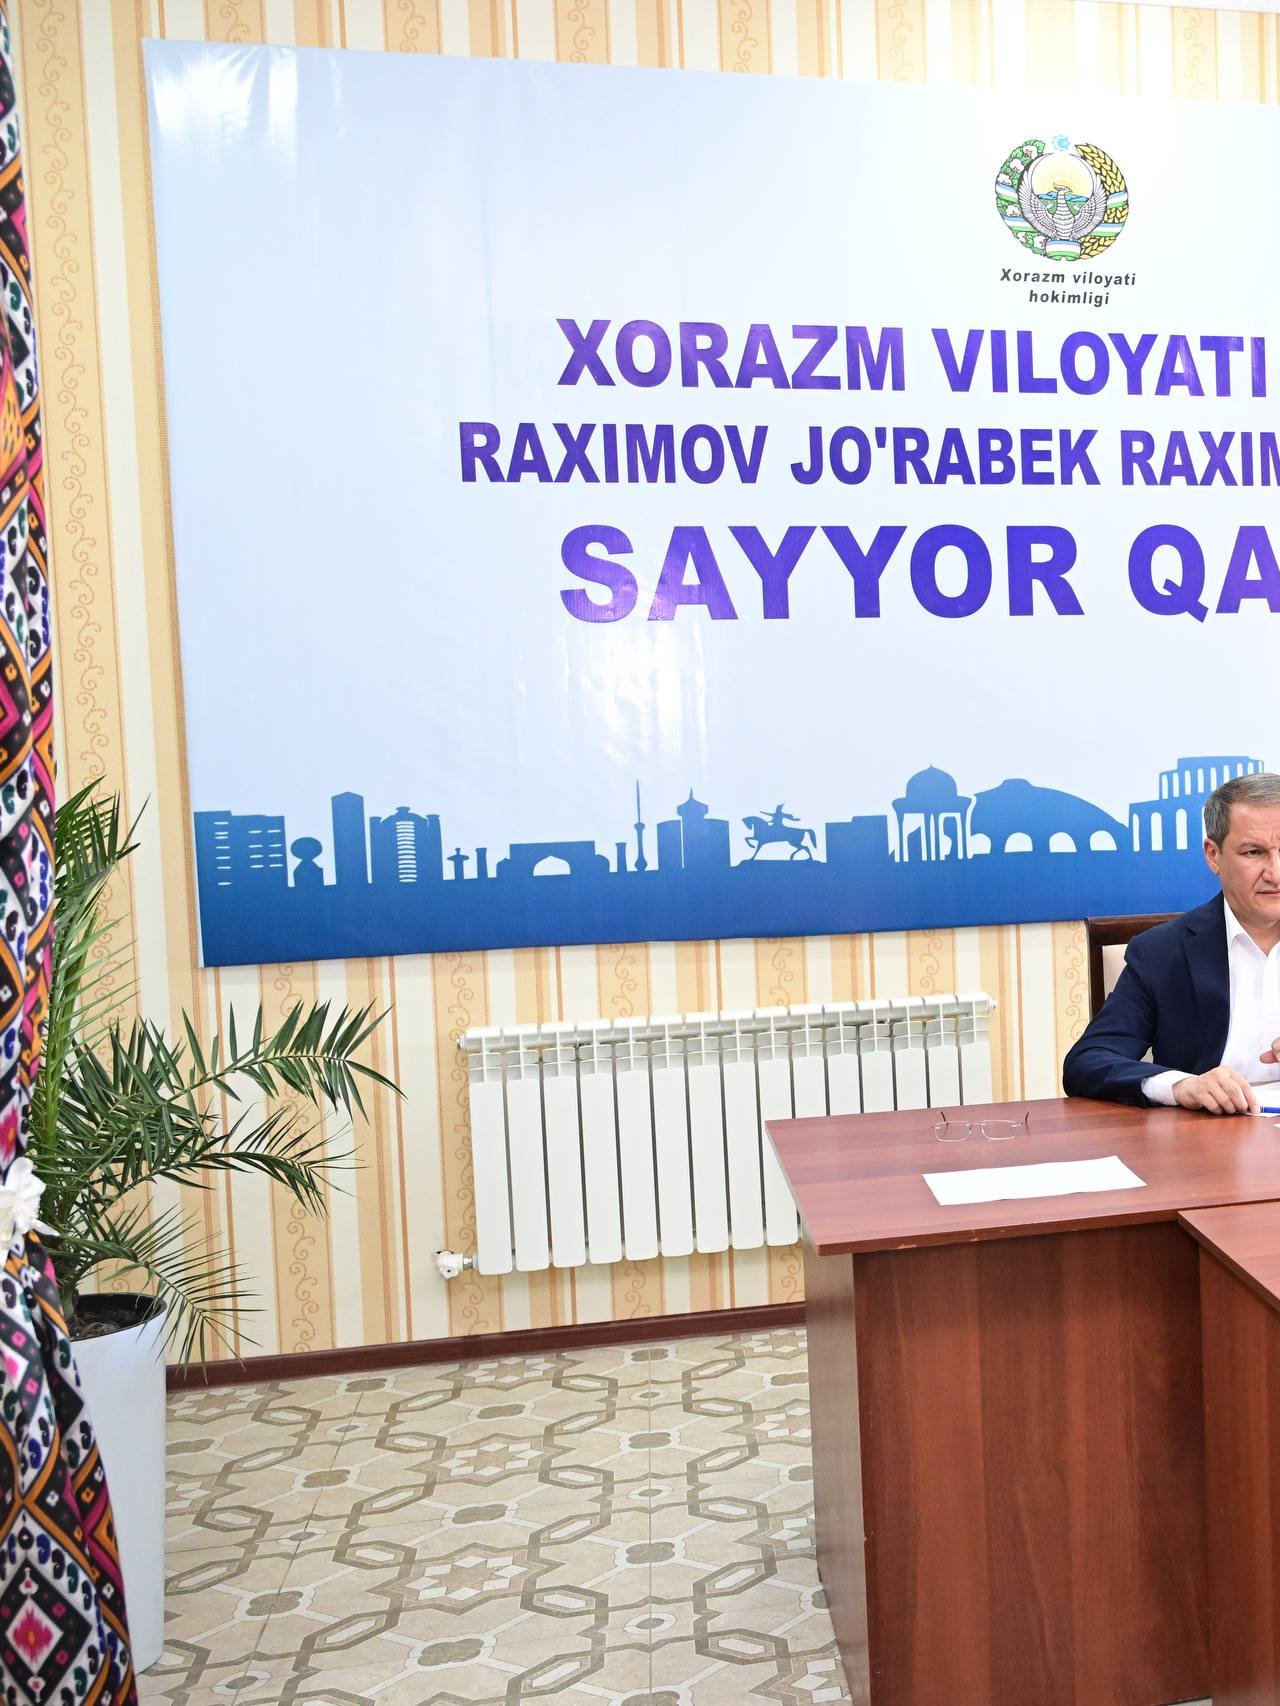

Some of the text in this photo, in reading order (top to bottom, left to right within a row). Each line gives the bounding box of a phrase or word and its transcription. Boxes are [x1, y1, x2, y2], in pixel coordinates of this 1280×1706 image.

[1000, 268, 1136, 288] Xorazm viloyati
[1029, 289, 1110, 308] hokimligi
[556, 318, 906, 392] XORAZM
[931, 328, 1267, 399] VILOYATI
[458, 421, 769, 485] RAXIMOV
[790, 425, 1101, 486] JO'RABEK
[559, 524, 1085, 624] SAYYOR
